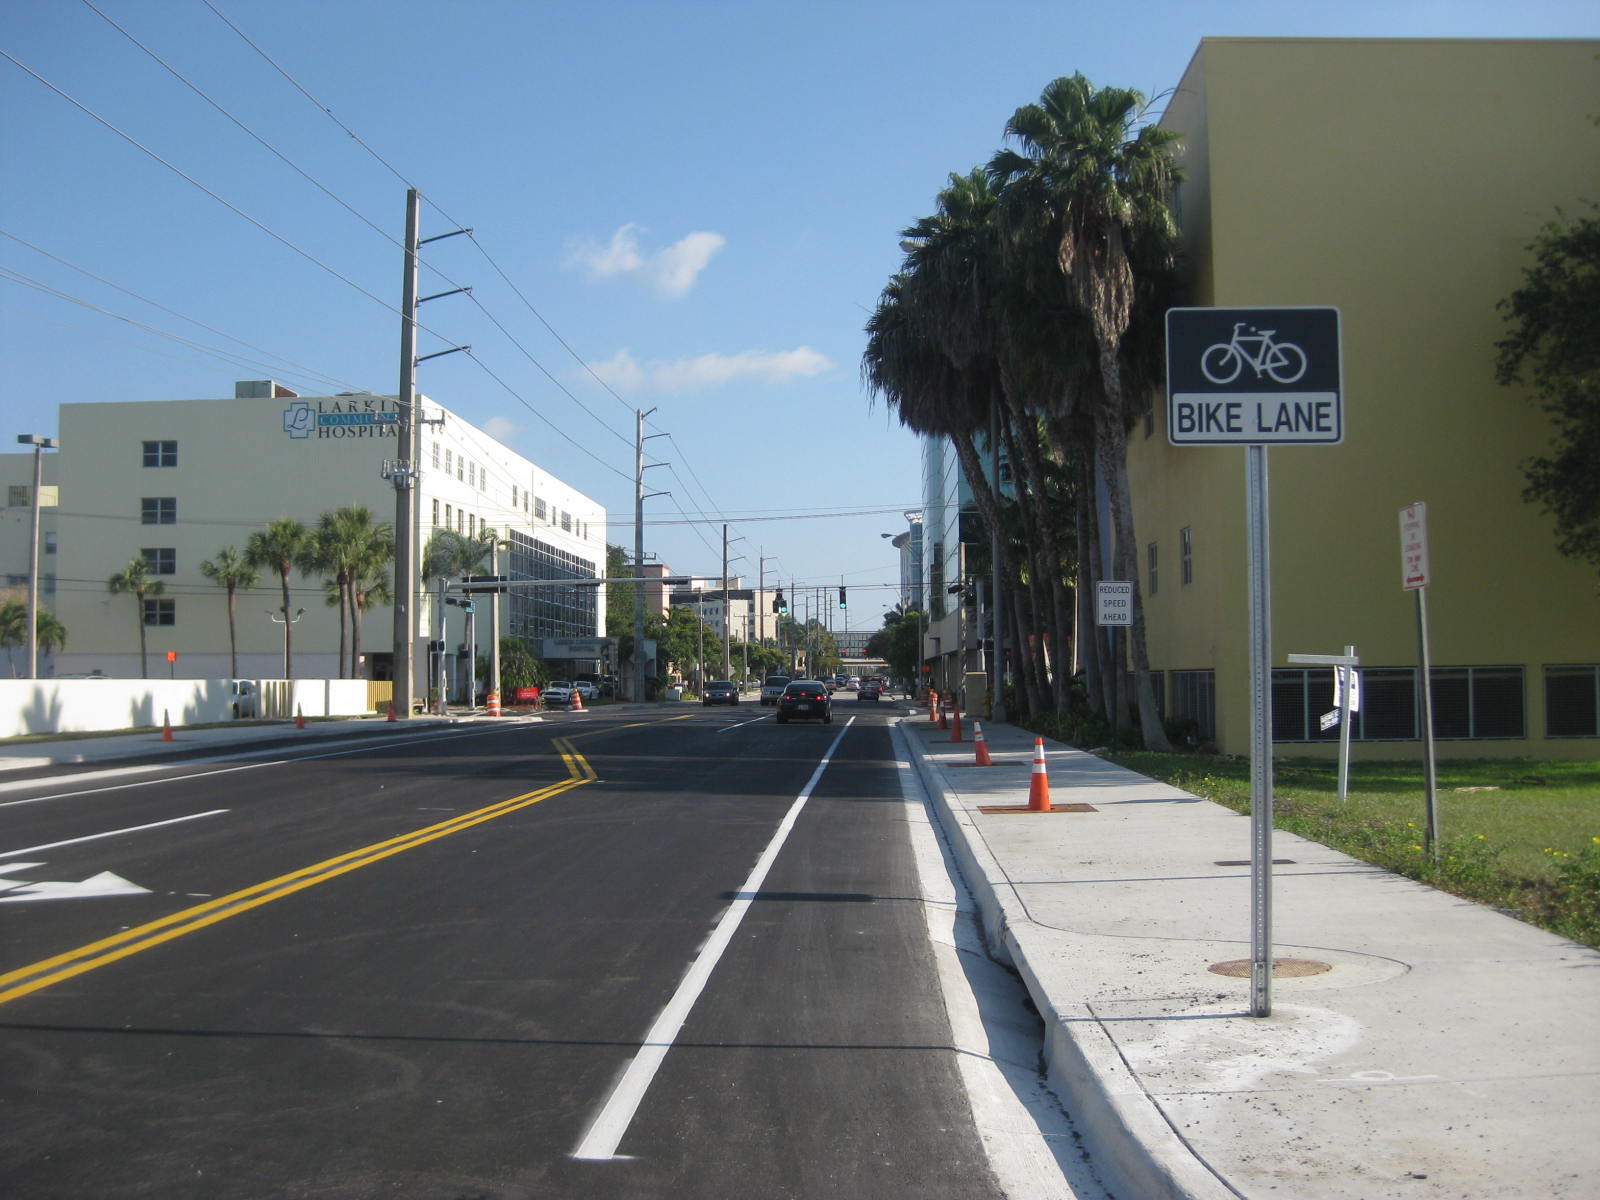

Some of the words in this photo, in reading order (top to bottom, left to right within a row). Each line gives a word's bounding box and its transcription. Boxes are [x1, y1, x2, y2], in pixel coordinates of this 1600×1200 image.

[1178, 403, 1242, 433] BIKE
[1257, 402, 1332, 432] LANE
[319, 425, 398, 438] HOSPITA
[1099, 586, 1129, 594] REDUCED
[1103, 599, 1126, 607] SPEED
[1103, 613, 1126, 621] AHEAD
